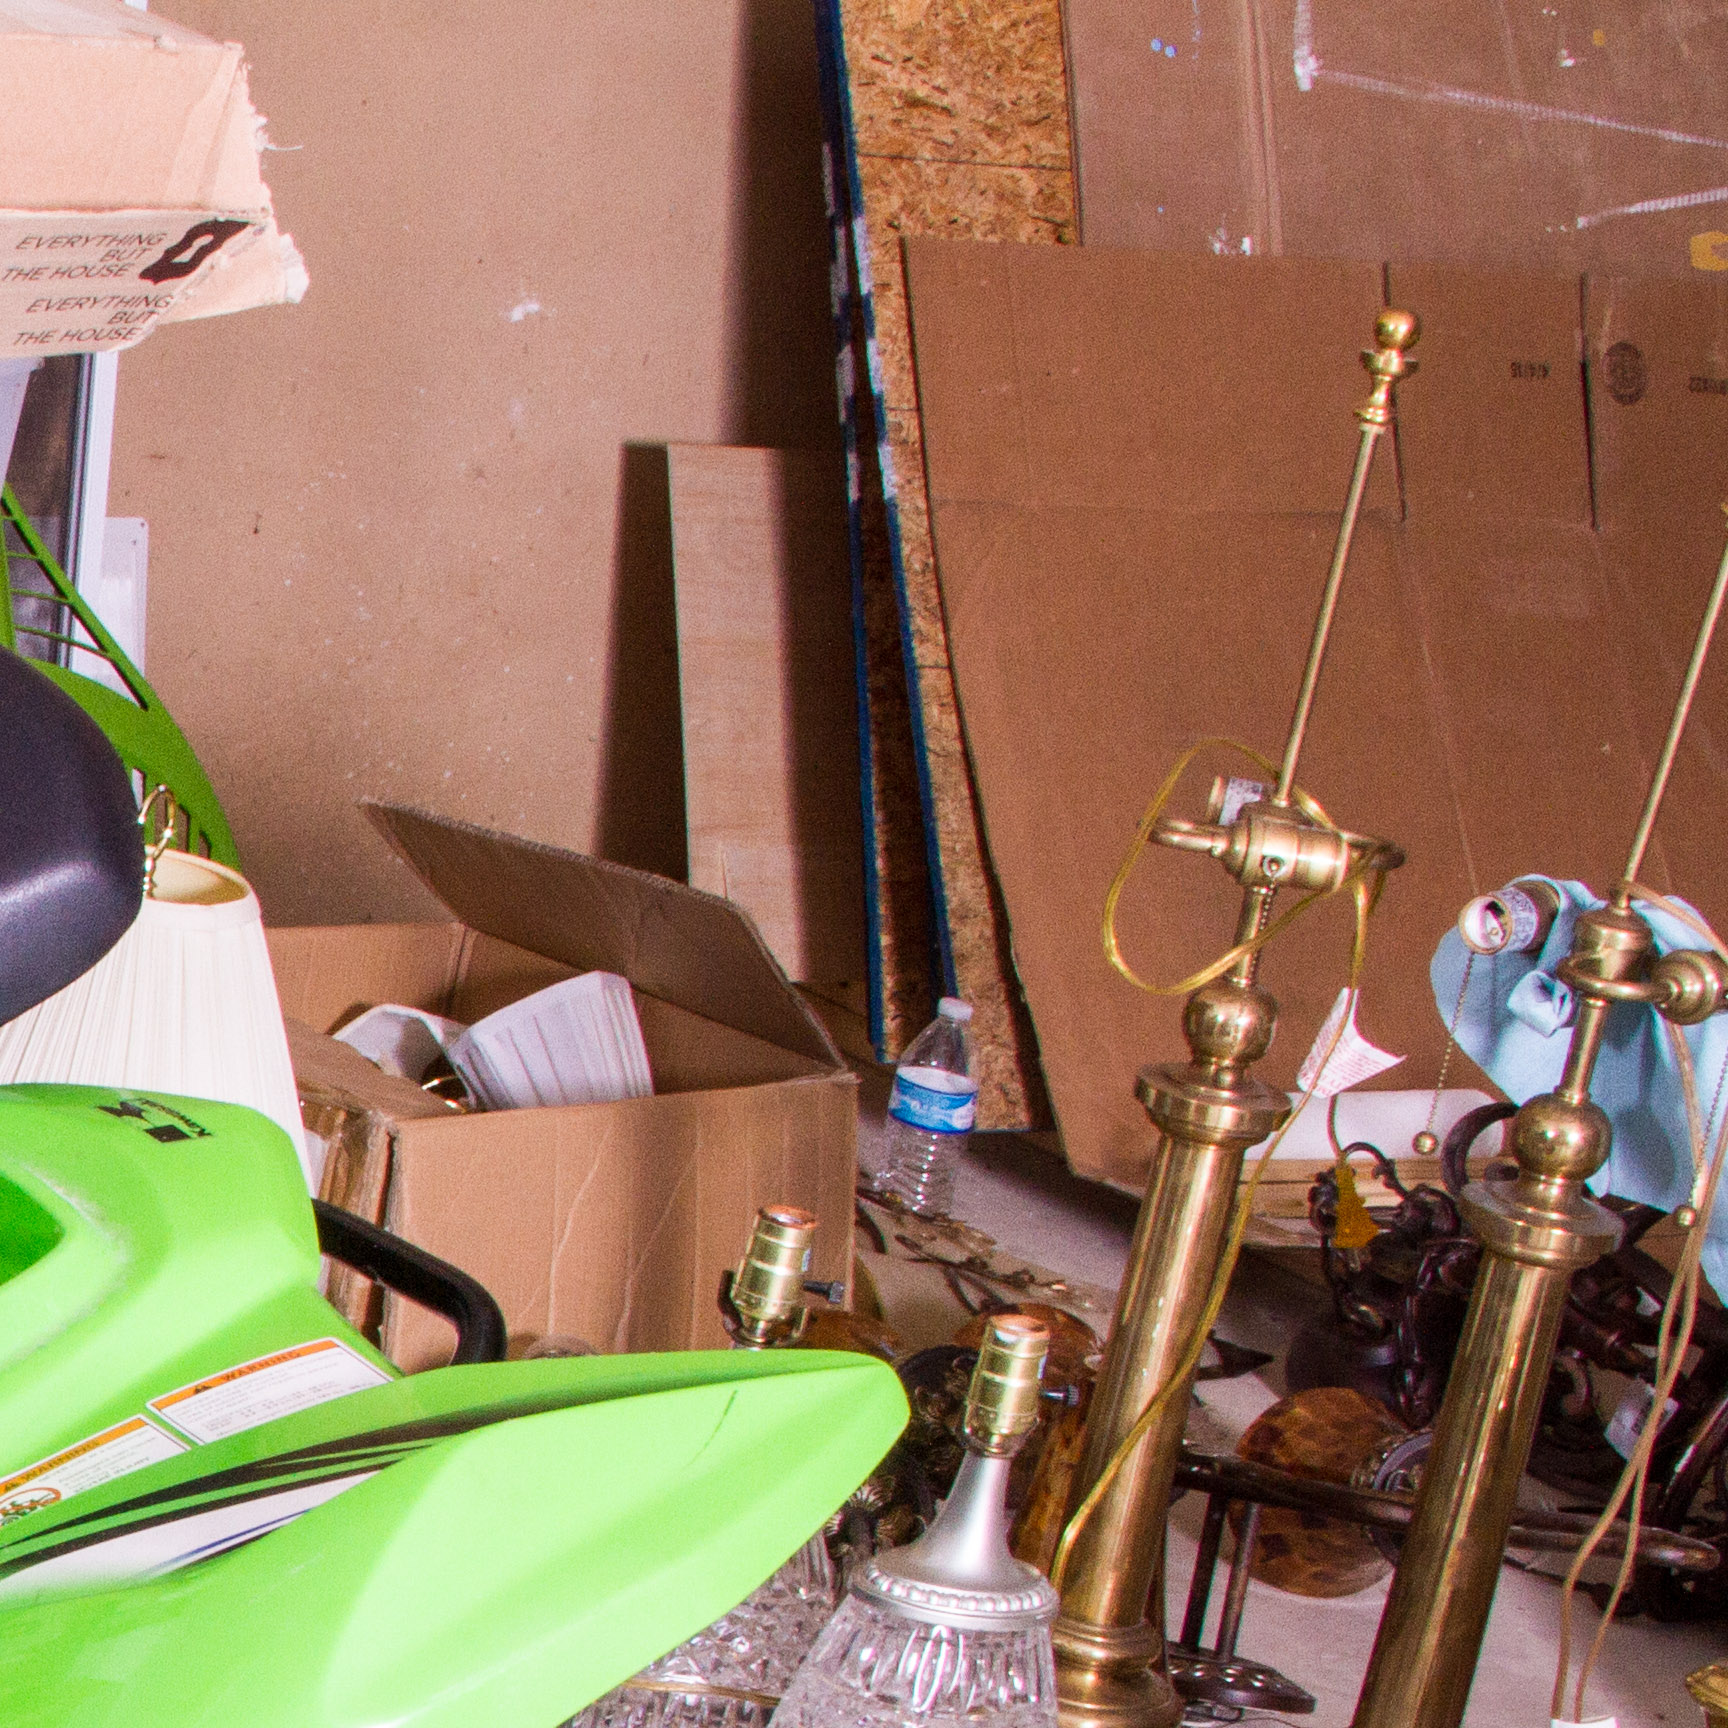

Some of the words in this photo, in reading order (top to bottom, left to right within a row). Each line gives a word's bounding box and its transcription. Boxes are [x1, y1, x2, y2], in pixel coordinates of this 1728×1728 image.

[15, 232, 167, 250] EVERYTHING
[99, 248, 152, 262] BUT
[2, 266, 50, 282] THE
[49, 263, 135, 279] HOUSE
[26, 294, 175, 314] EVERYTHING
[107, 311, 160, 325] BUT
[13, 330, 57, 345] THE
[59, 327, 144, 343] HOUSE
[222, 1350, 301, 1382] WARNING
[22, 1439, 100, 1482] WARNING
